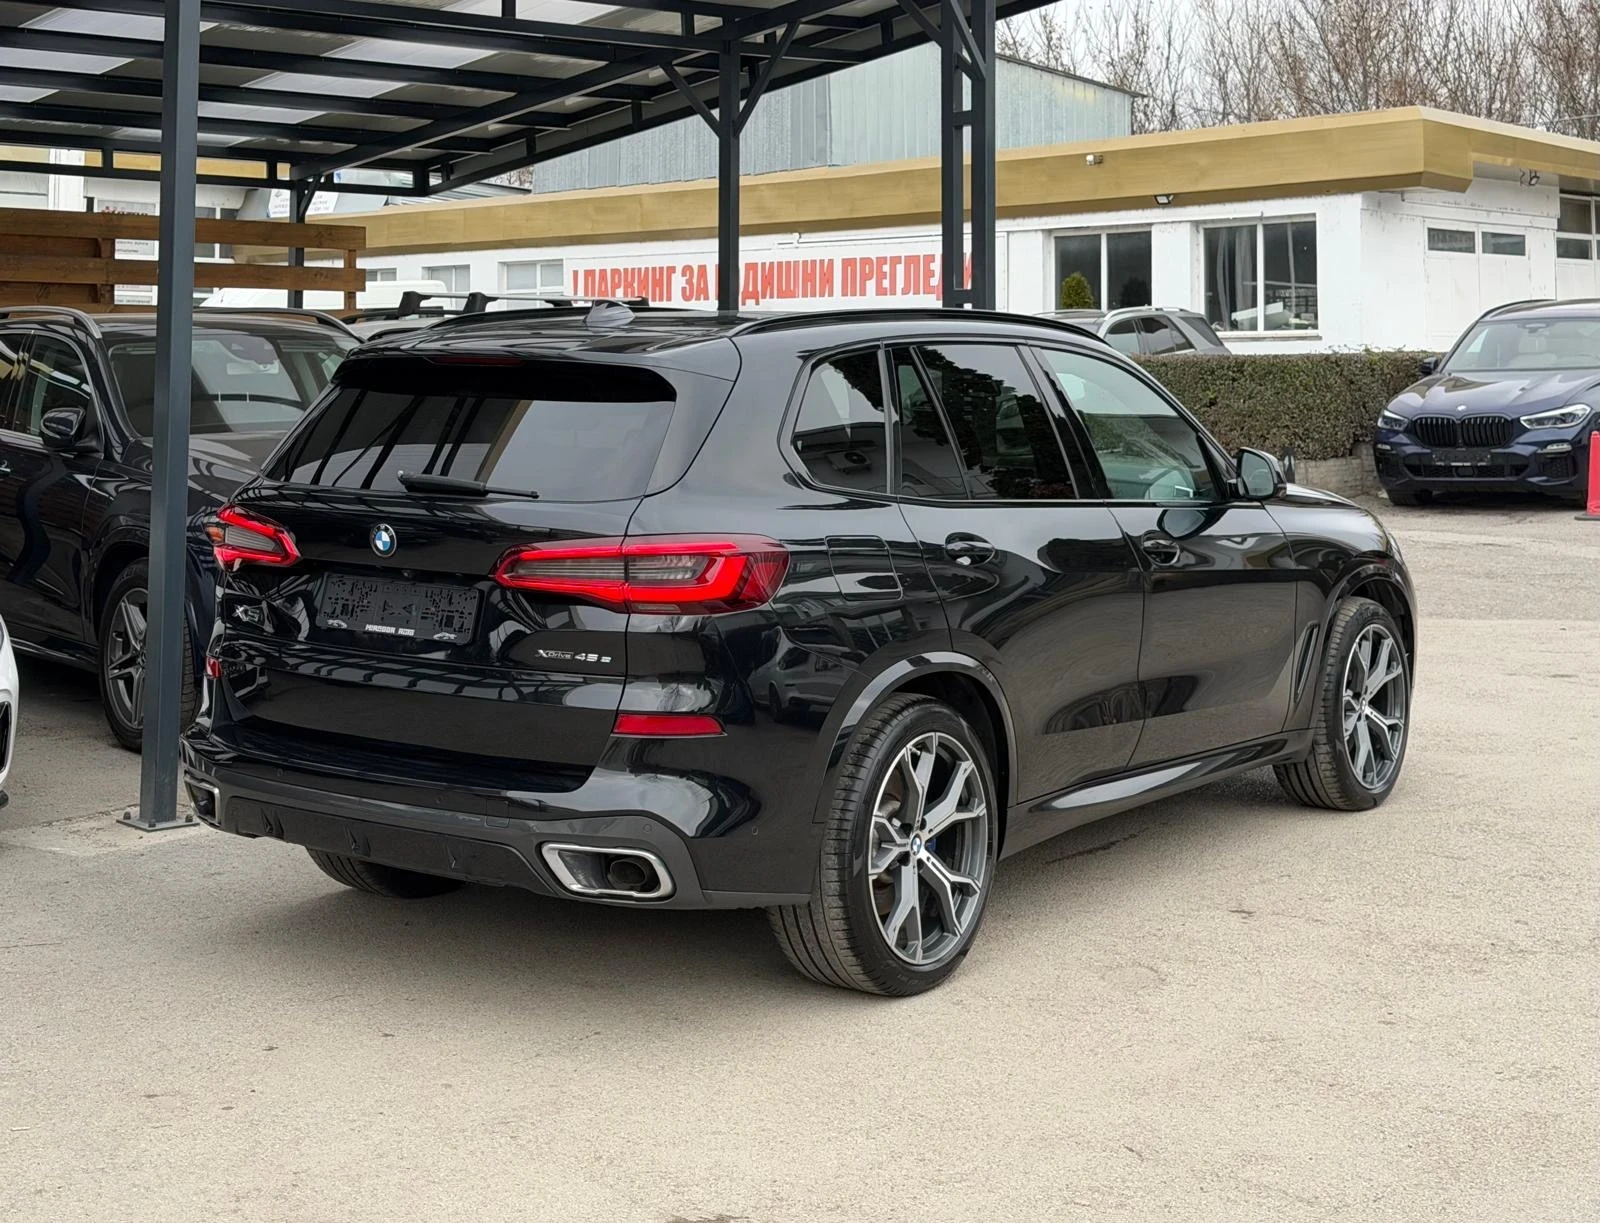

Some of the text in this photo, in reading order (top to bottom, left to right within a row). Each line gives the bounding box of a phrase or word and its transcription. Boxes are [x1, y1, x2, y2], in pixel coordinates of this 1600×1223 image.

[583, 265, 677, 303] ПАРКИНГ
[681, 264, 710, 302] ЗА
[715, 258, 834, 306] ДИШНИ
